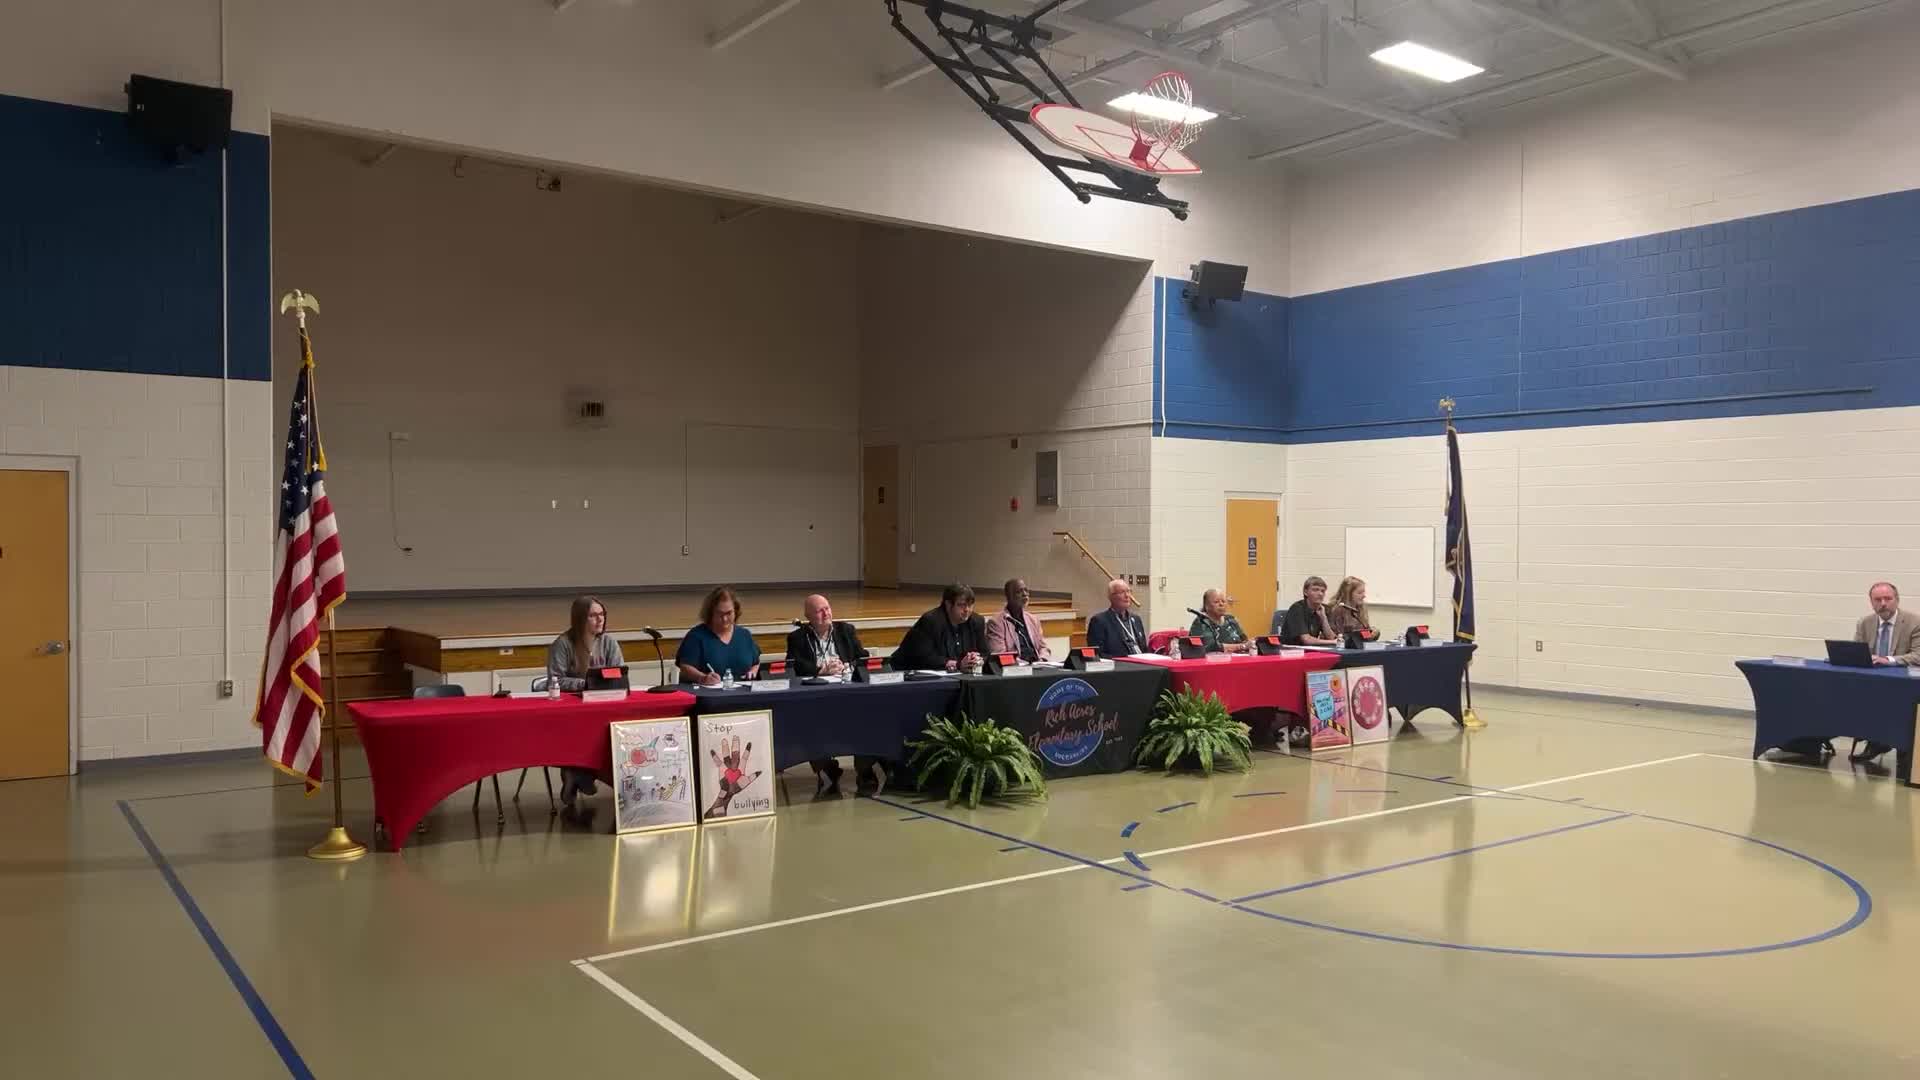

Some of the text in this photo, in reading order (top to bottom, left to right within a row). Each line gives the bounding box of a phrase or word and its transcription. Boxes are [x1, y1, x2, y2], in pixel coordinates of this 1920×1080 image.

[1045, 702, 1096, 728] Rich Acres
[1085, 711, 1120, 737] School
[706, 722, 734, 736] Stop
[734, 798, 770, 813] bullying
